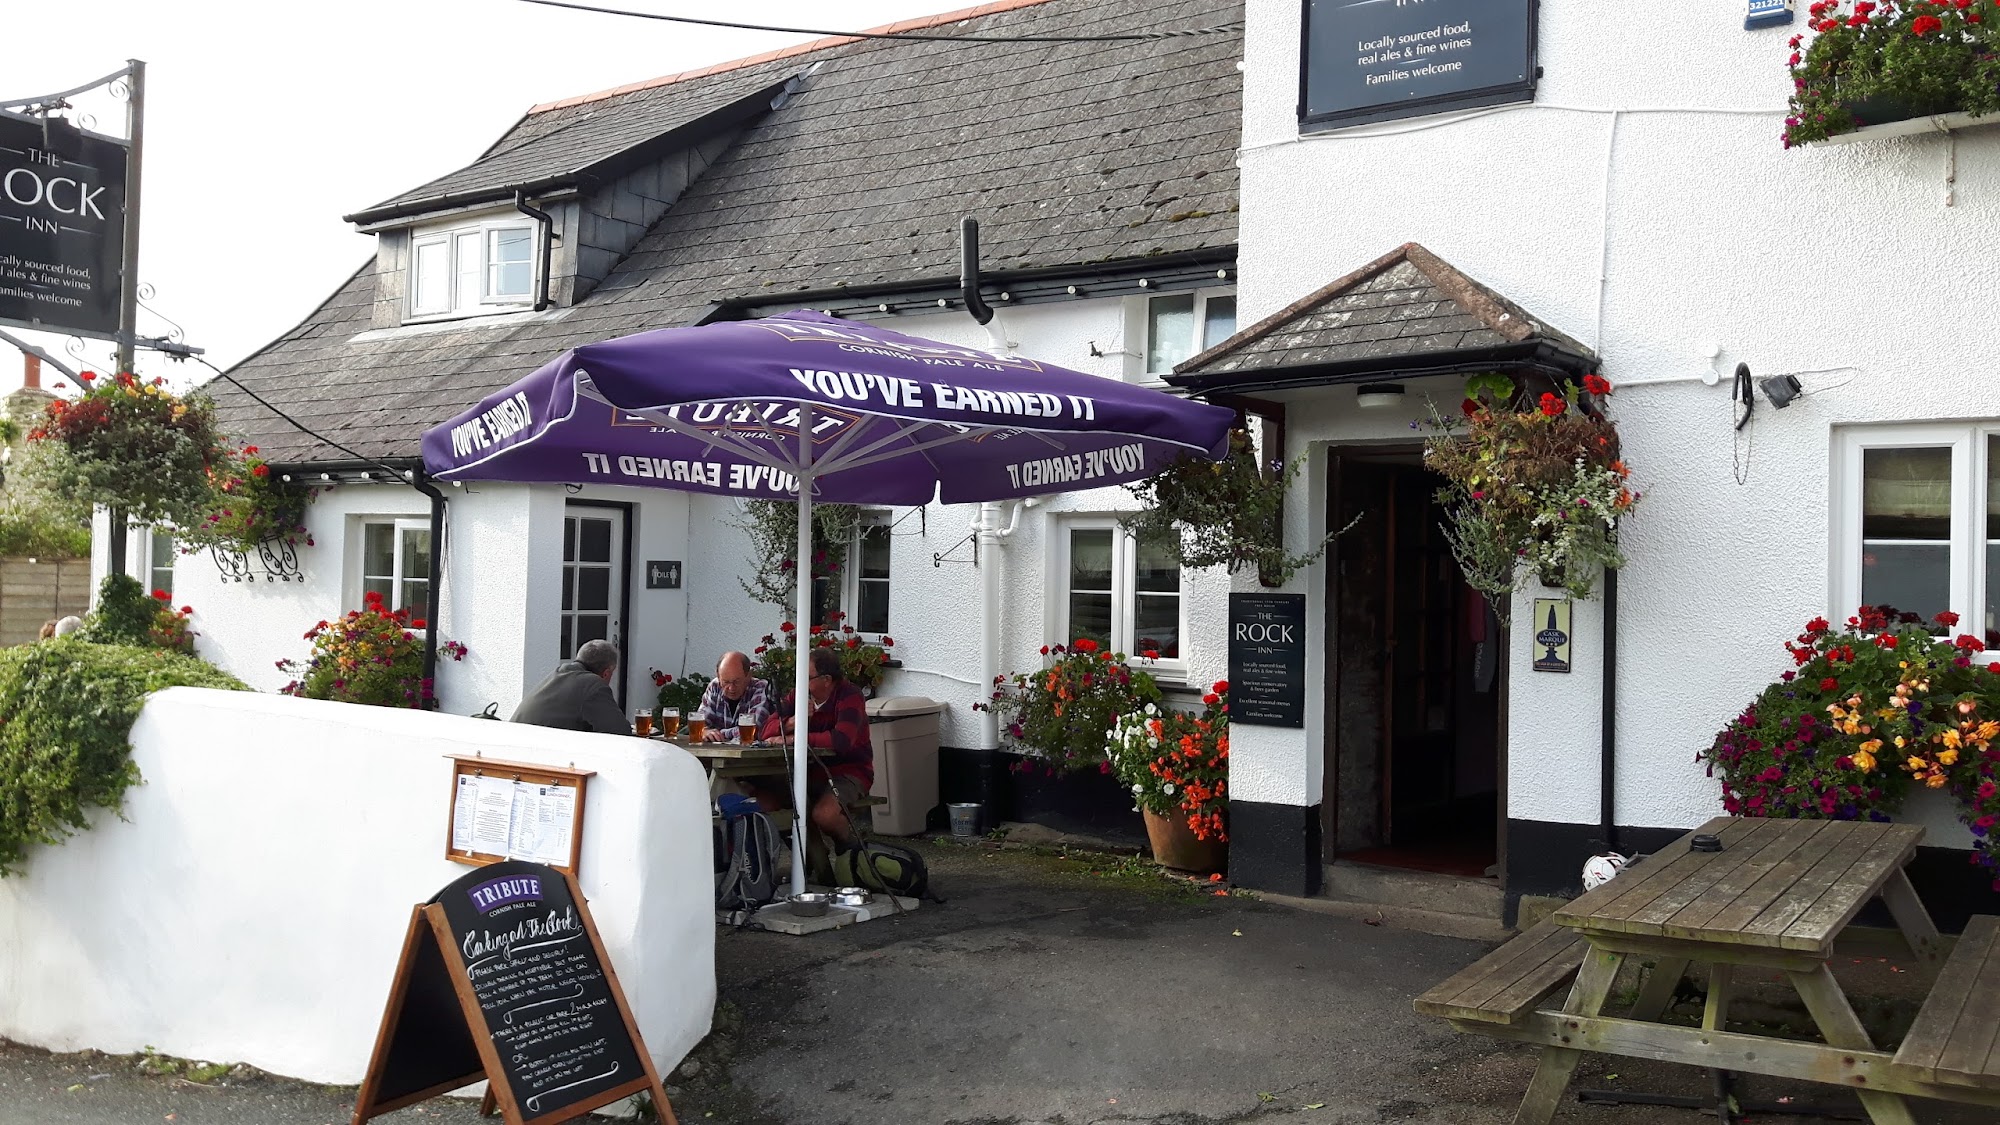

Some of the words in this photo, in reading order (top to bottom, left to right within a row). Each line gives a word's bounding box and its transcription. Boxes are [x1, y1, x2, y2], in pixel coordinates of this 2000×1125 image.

[1358, 36, 1396, 52] Locally
[1398, 29, 1441, 45] sourced
[1443, 20, 1472, 36] food,
[1357, 51, 1378, 66] real
[1380, 48, 1401, 62] ales
[1404, 47, 1413, 58] &
[1416, 42, 1437, 56] fine
[1439, 37, 1472, 51] wines
[1366, 69, 1410, 86] Families
[1412, 60, 1462, 78] welcome
[28, 148, 60, 168] THE
[0, 168, 106, 221] OCK
[26, 215, 58, 235] INN
[6, 268, 27, 280] ales
[29, 272, 38, 282] &
[41, 273, 60, 285] fine
[62, 278, 91, 290] wines
[24, 260, 64, 273] sourced
[66, 264, 91, 279] food,
[36, 293, 82, 307] welcome
[839, 344, 918, 362] CORNISH
[923, 358, 964, 368] PALE
[789, 368, 923, 408] YOU'VE
[930, 382, 1061, 418] EARNED
[1071, 397, 1096, 421] IT
[451, 417, 491, 458] YOU'VE
[1257, 612, 1273, 620] THE
[1236, 623, 1294, 643] ROCK
[1258, 646, 1273, 655] INN
[473, 879, 540, 907] TRIBUTE
[489, 906, 512, 918] CORNISH
[463, 930, 511, 960] Parking
[512, 1053, 529, 1063] OR
